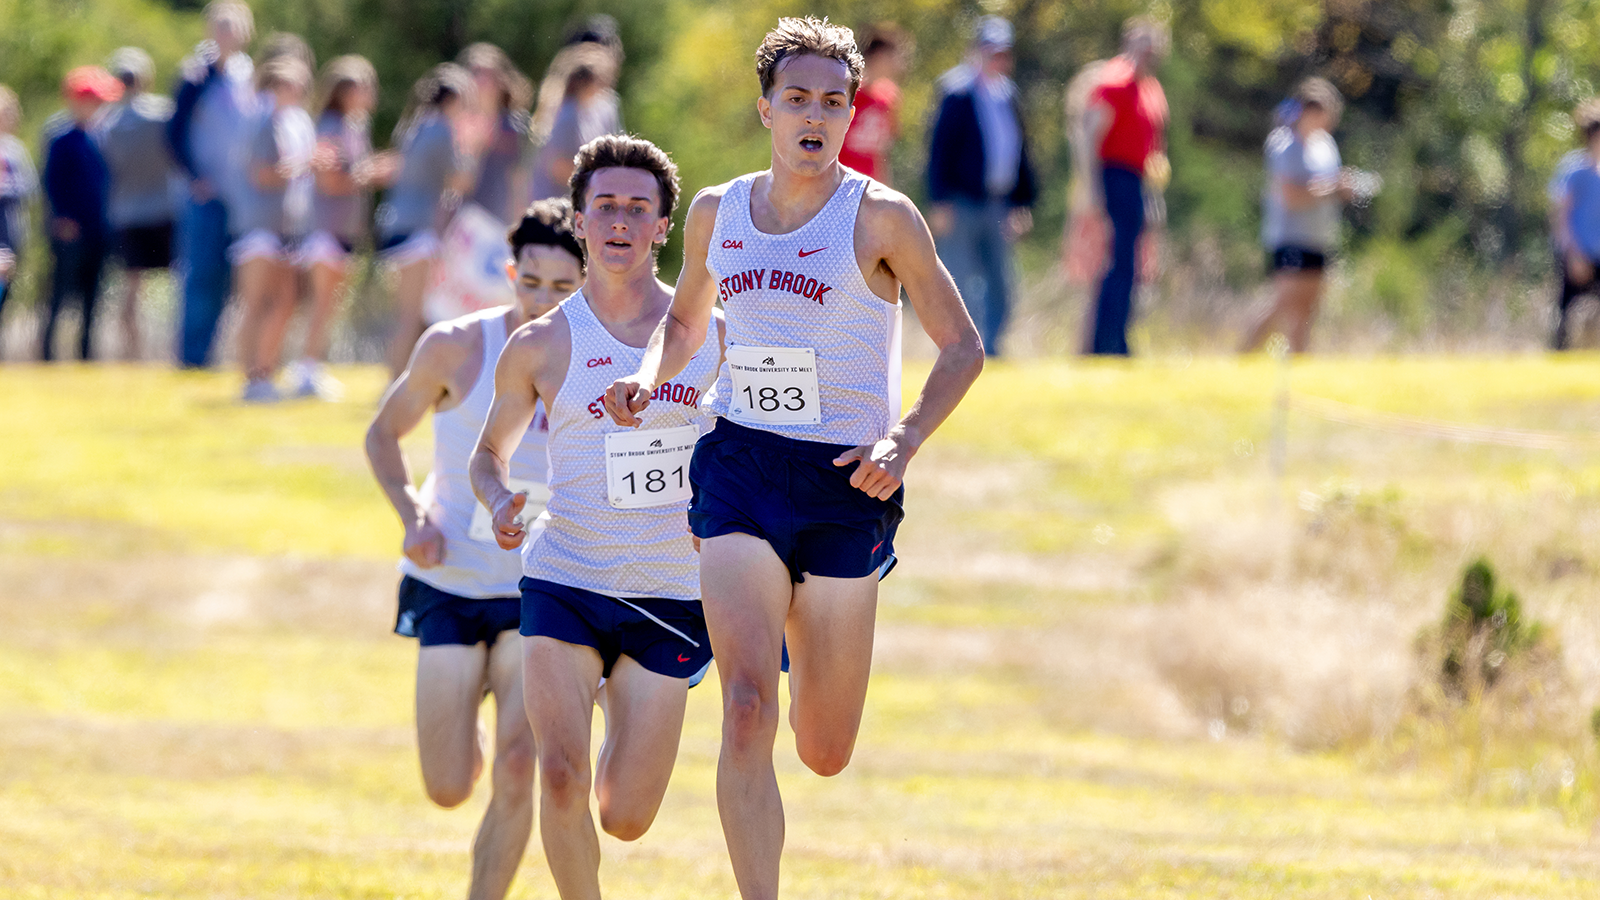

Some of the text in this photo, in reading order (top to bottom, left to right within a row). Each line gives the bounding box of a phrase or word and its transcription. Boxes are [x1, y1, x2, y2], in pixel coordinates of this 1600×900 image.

[722, 239, 743, 250] CAA
[719, 268, 832, 306] STONY BROOK
[587, 356, 613, 368] CAA
[742, 385, 806, 412] 183
[646, 447, 676, 455] UNIVERSITY
[622, 465, 683, 494] 181
